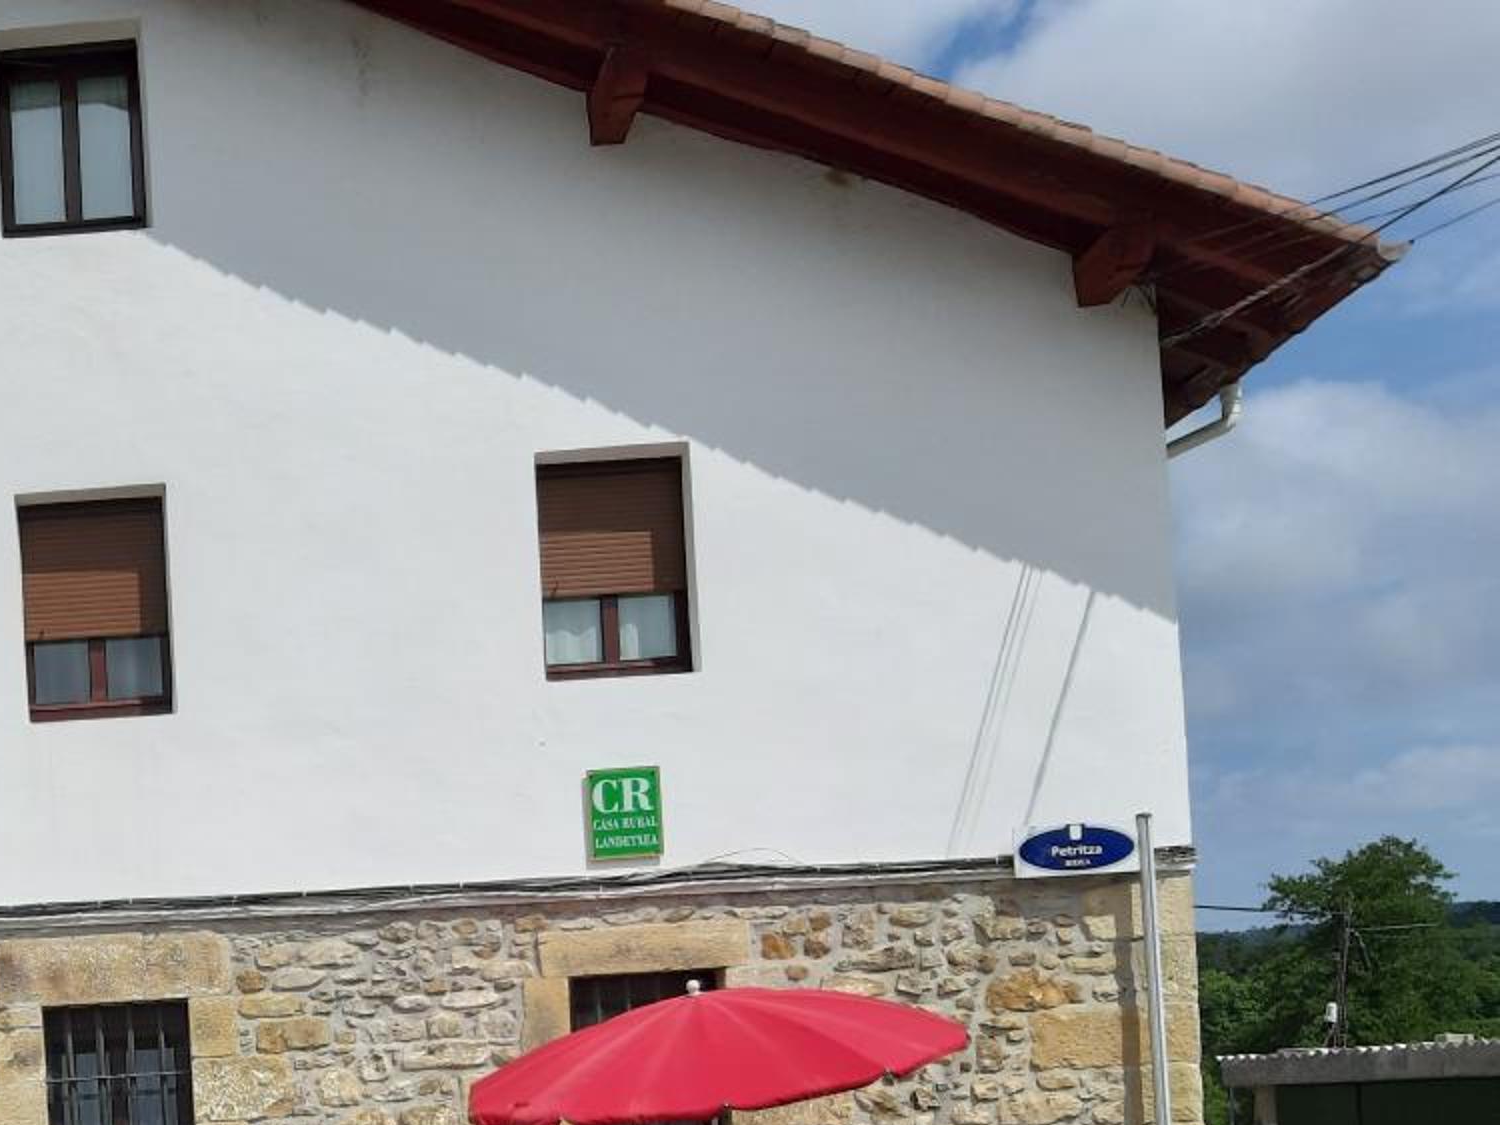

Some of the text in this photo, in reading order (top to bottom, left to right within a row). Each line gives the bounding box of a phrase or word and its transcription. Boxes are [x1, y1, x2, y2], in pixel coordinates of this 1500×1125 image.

[592, 777, 655, 813] CR
[593, 815, 657, 831] CASA RURAL
